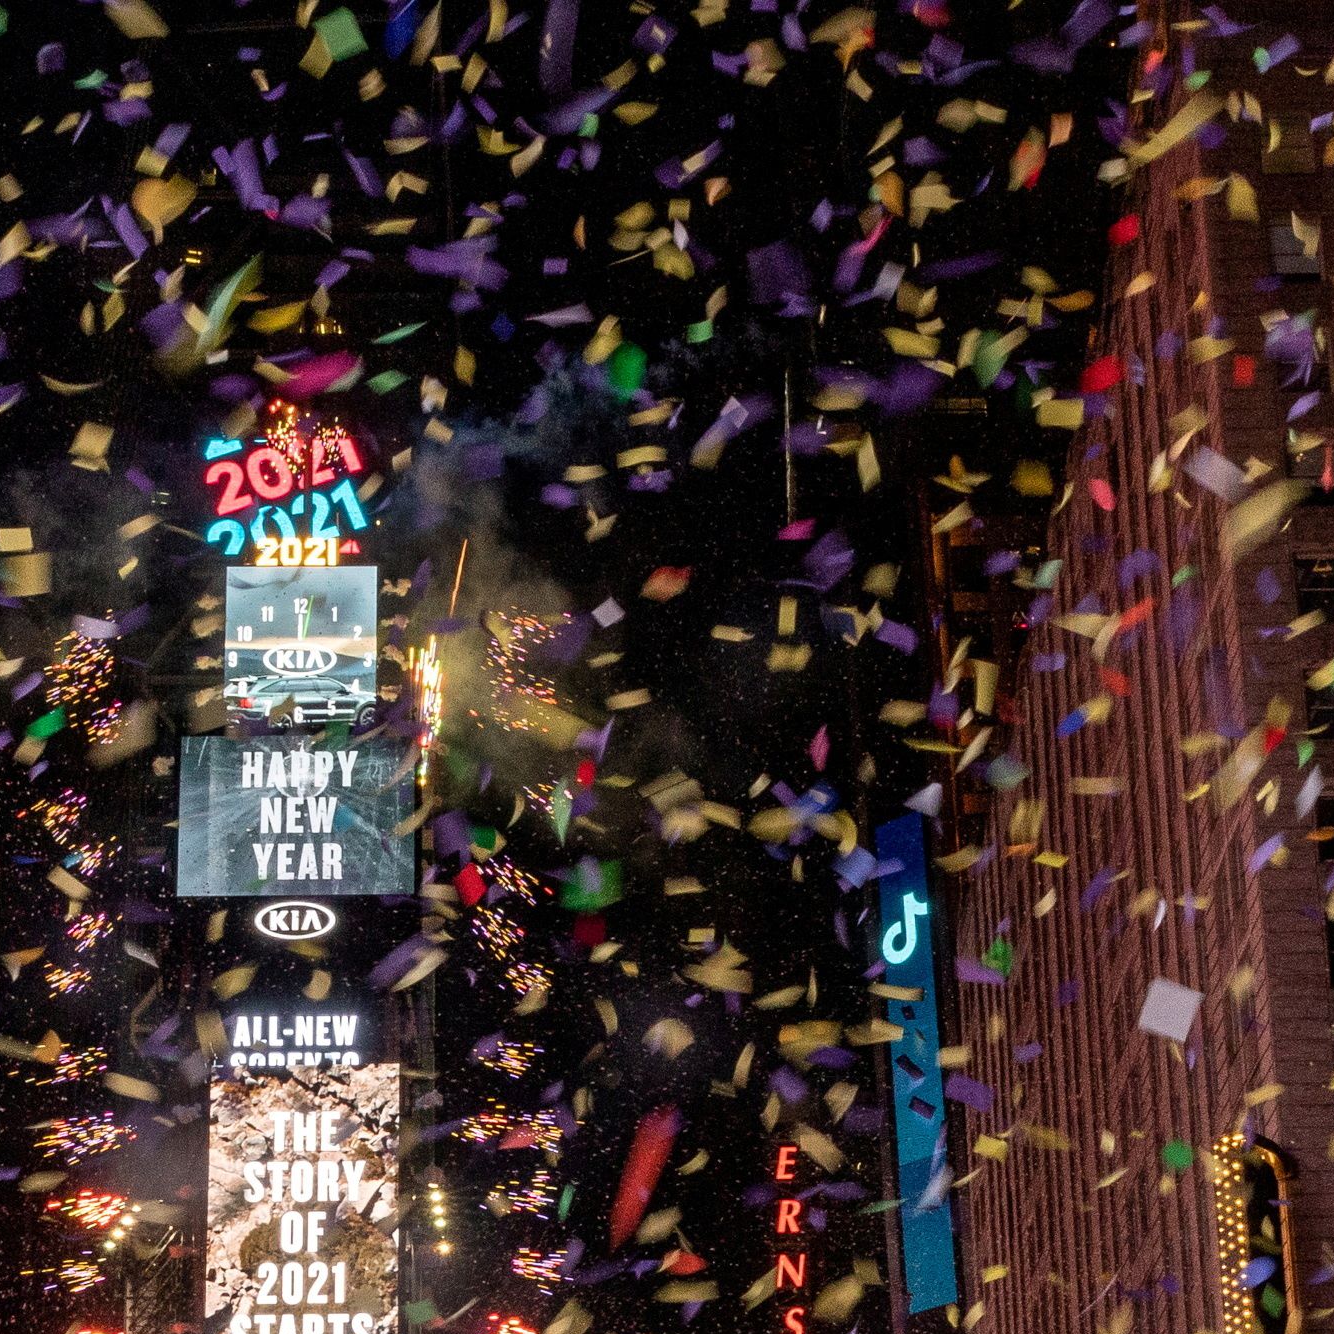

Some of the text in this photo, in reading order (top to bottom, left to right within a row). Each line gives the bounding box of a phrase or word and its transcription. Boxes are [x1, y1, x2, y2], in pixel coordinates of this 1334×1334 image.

[255, 537, 339, 567] 2021
[261, 606, 274, 622] 11
[294, 598, 307, 614] 12
[237, 626, 253, 642] 10
[276, 650, 325, 669] KIA
[241, 750, 359, 789] HAPPY
[260, 797, 338, 834] NEW
[252, 842, 344, 882] YEAR
[269, 909, 322, 932] KIA
[233, 1015, 358, 1048] ALL-NEW
[269, 1111, 341, 1152] THE
[242, 1160, 366, 1202] STORY
[280, 1211, 327, 1254] OF
[256, 1261, 347, 1306] 2021
